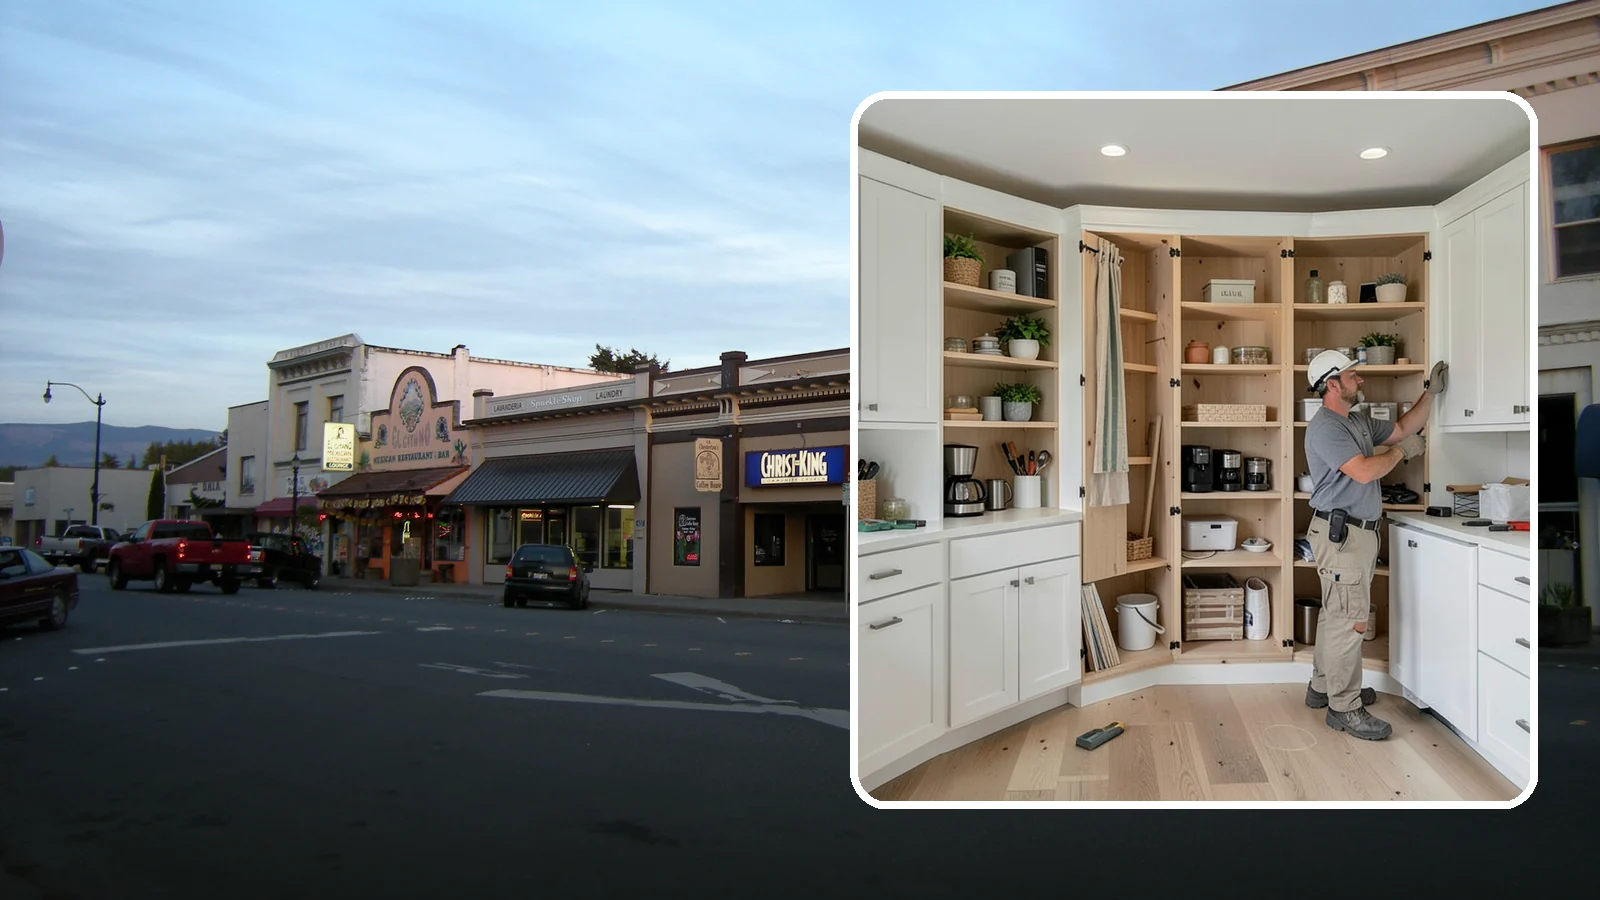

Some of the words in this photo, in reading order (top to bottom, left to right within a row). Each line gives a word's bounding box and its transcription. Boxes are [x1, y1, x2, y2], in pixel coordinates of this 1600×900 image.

[596, 388, 624, 400] LAUNDRY
[494, 402, 522, 412] LAVANDERIA
[530, 398, 560, 410] Sparkle
[560, 394, 583, 405] Shop
[392, 425, 402, 449] EL
[374, 454, 396, 464] MEXICAN
[398, 452, 434, 462] RESTAURANT
[438, 450, 450, 458] BAR
[760, 452, 798, 478] CHRIST
[800, 450, 827, 476] KING
